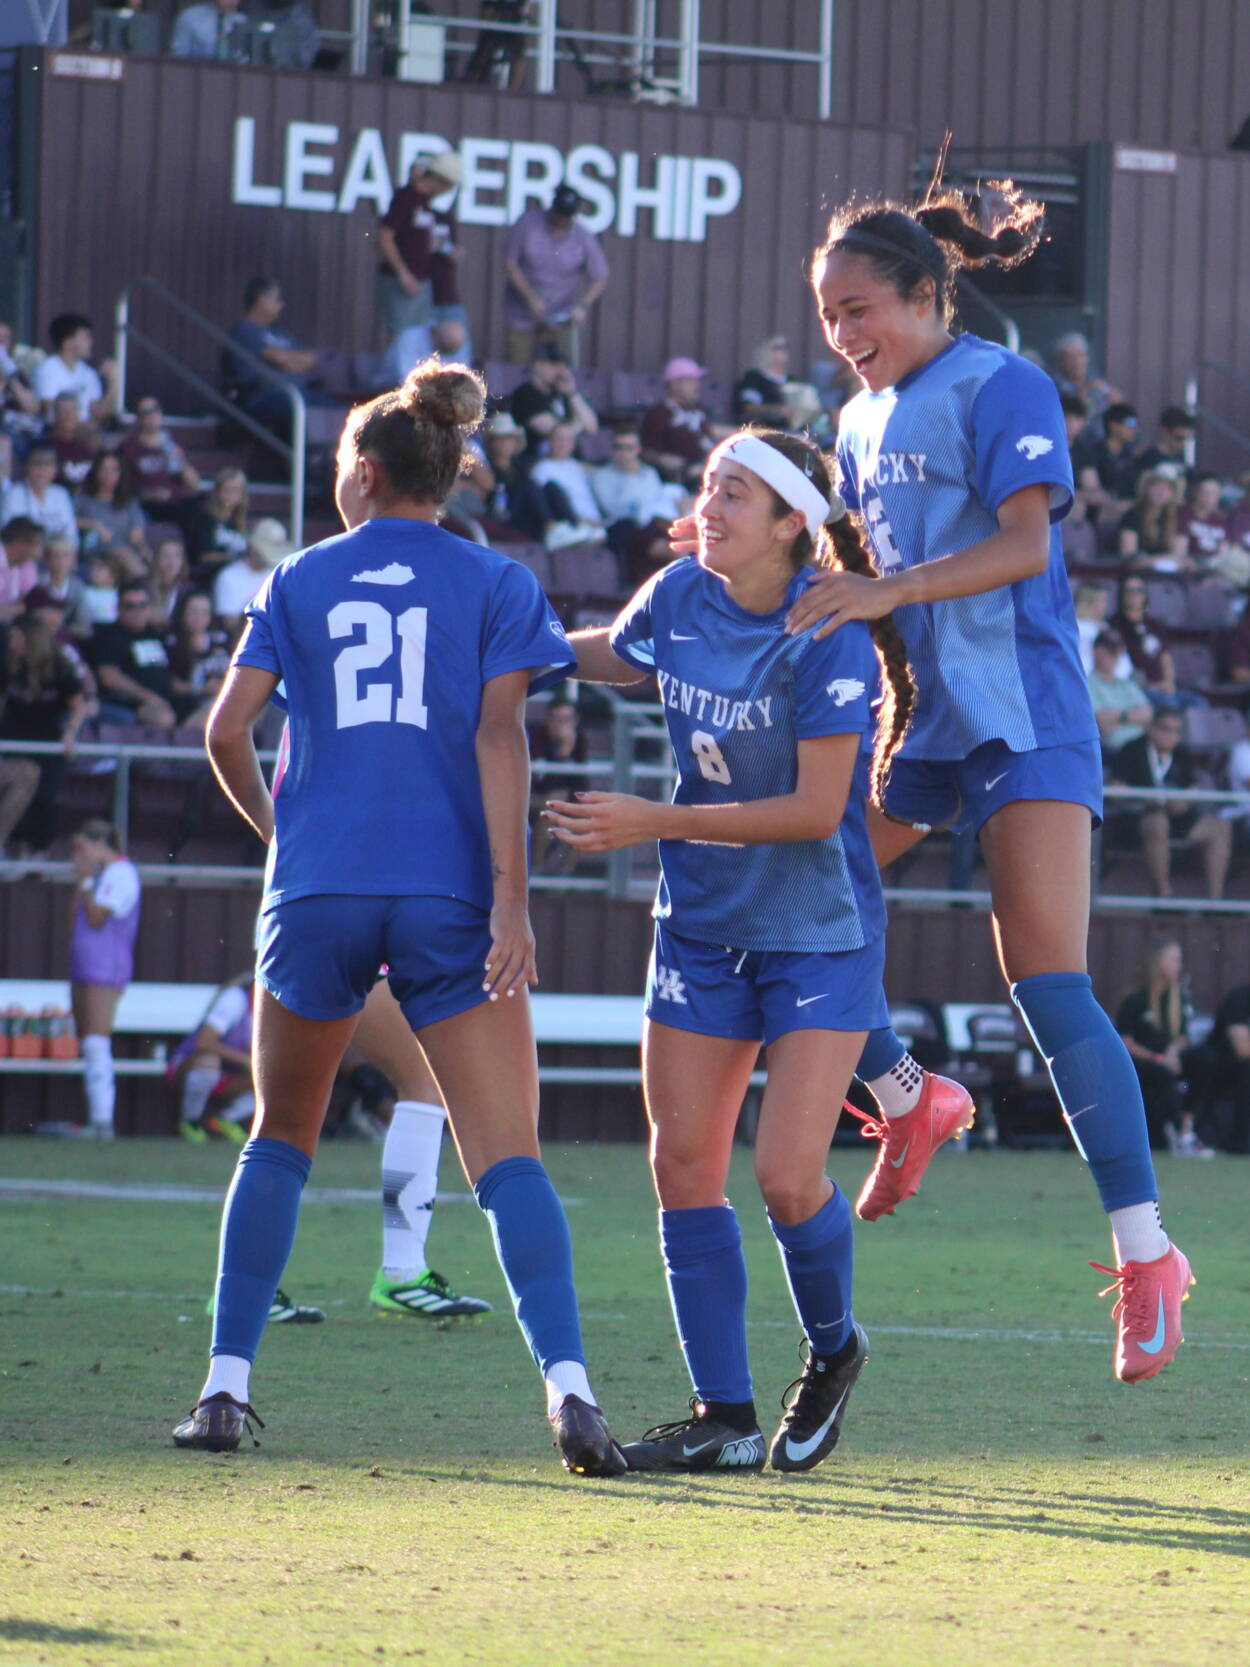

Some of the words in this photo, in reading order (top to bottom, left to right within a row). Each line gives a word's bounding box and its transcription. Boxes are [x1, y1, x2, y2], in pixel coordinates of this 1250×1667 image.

[233, 116, 742, 241] LEADERSHIP
[327, 601, 428, 731] 21
[691, 729, 732, 786] 8
